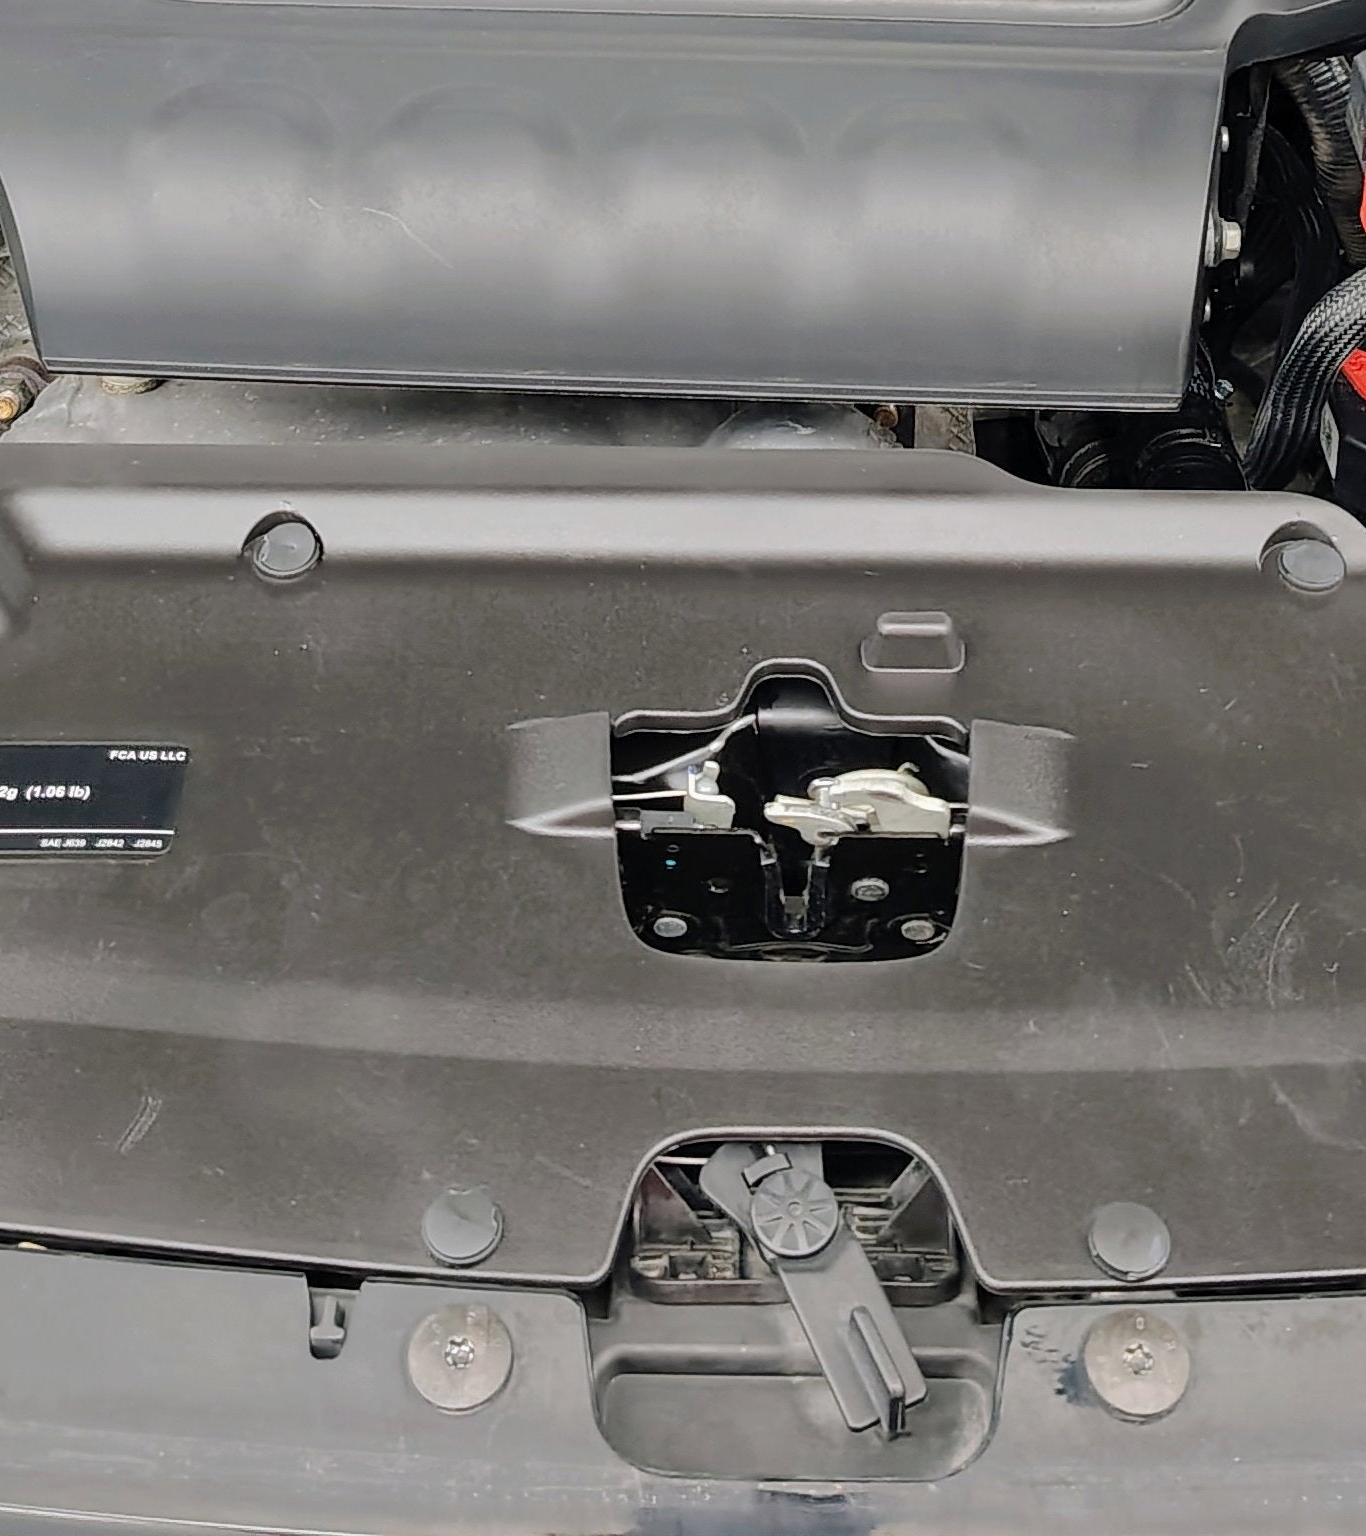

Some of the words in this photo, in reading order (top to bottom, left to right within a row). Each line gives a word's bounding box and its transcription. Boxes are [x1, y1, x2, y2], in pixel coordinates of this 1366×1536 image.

[108, 749, 136, 762] FCA
[139, 749, 158, 762] US
[160, 749, 187, 762] LLC
[25, 785, 67, 802] (1.06
[67, 785, 91, 801] lb)
